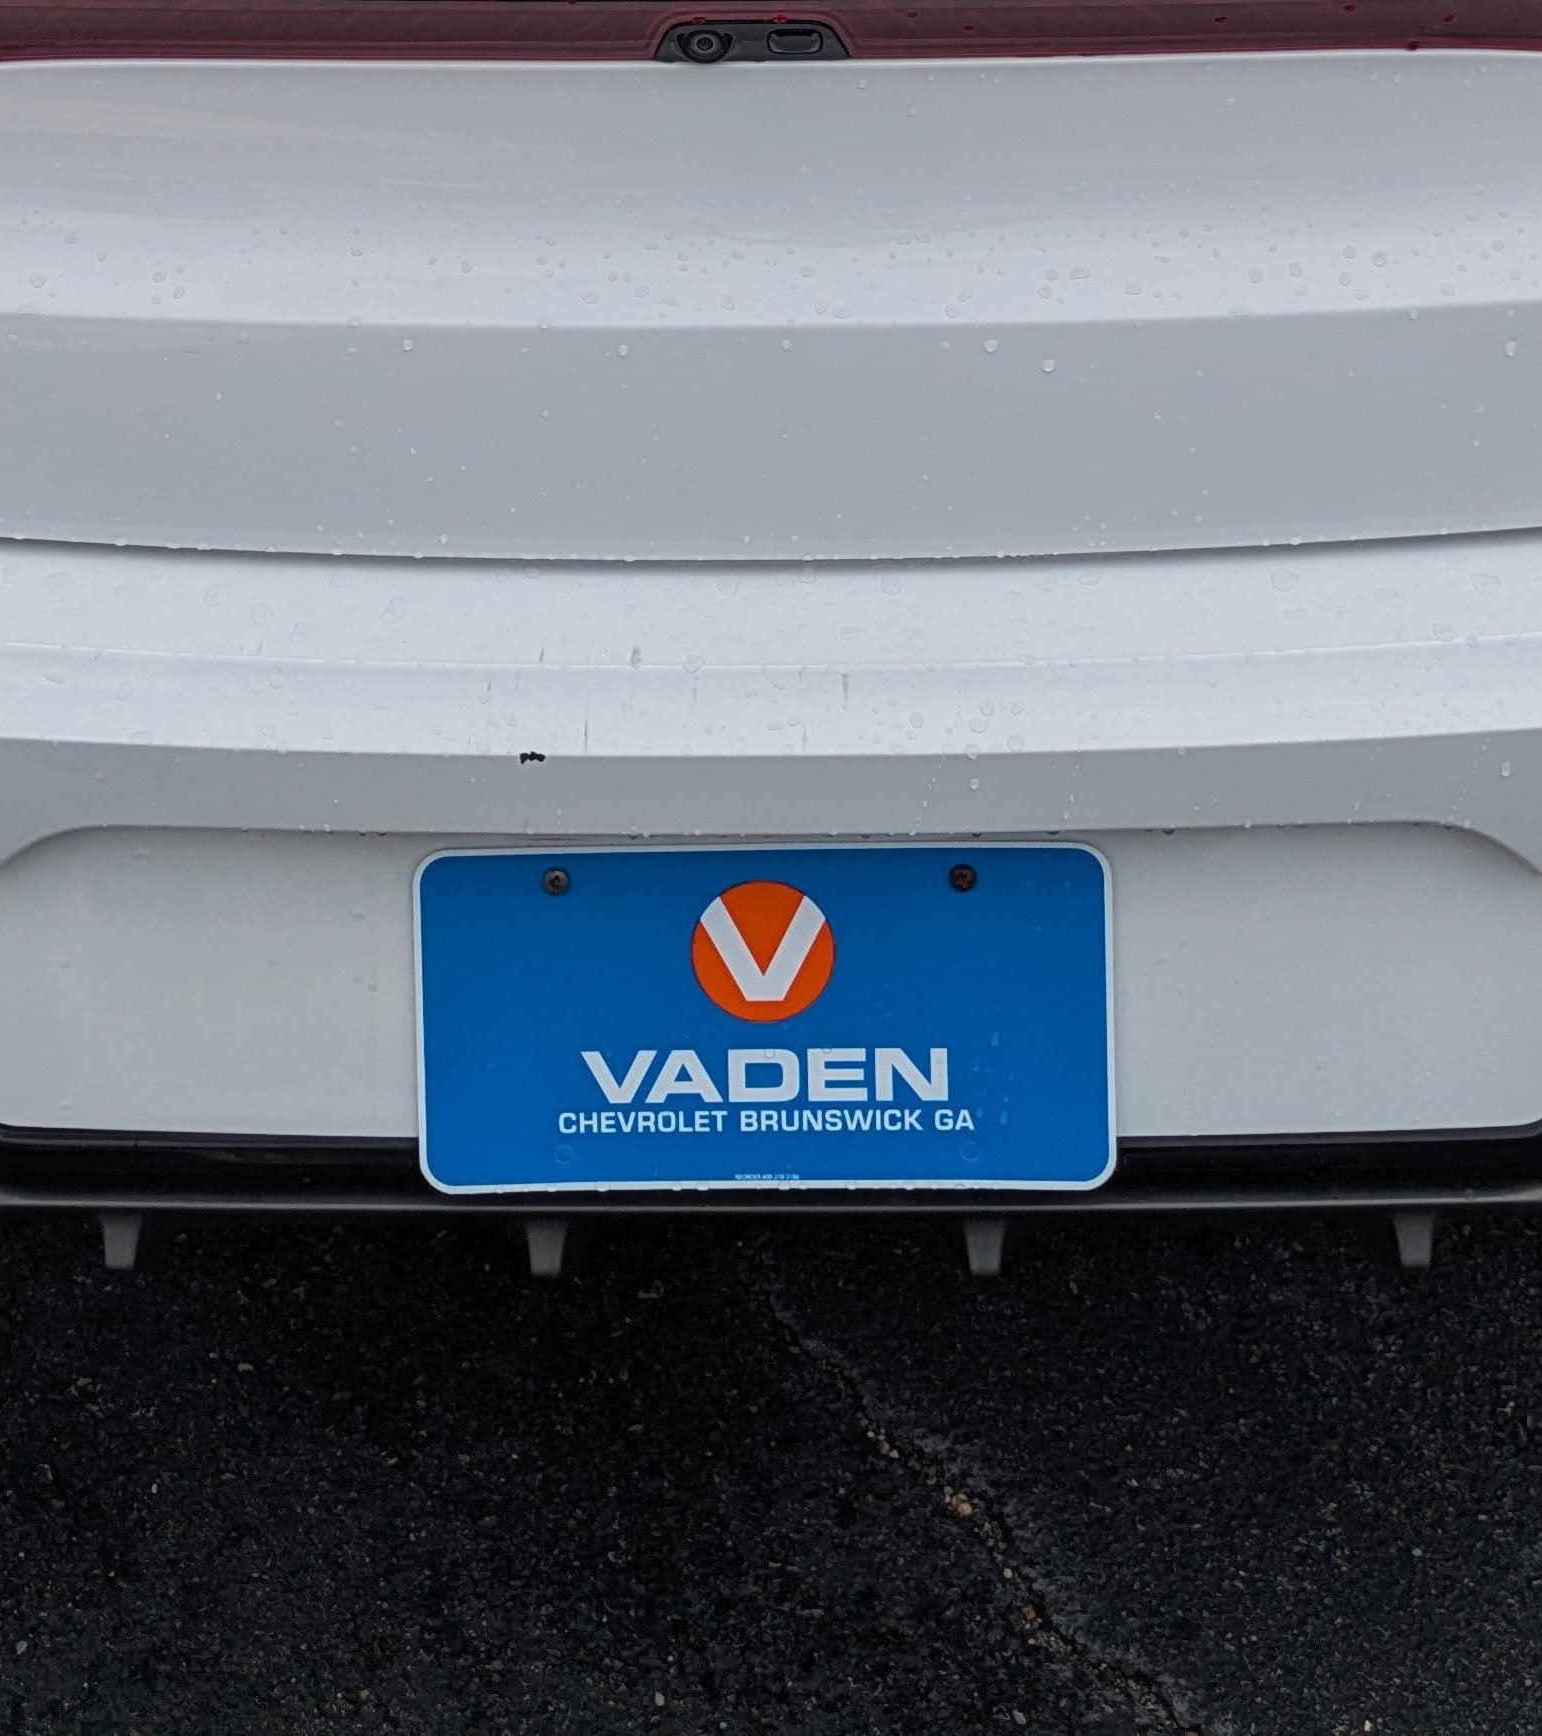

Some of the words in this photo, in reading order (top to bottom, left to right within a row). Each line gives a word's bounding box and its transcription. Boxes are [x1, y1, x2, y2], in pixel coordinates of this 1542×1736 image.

[699, 895, 826, 1002] V
[581, 1047, 949, 1104] VADEN
[558, 1110, 727, 1134] CHEVROLET
[740, 1109, 923, 1133] BRUNSWICK
[934, 1108, 975, 1132] GA
